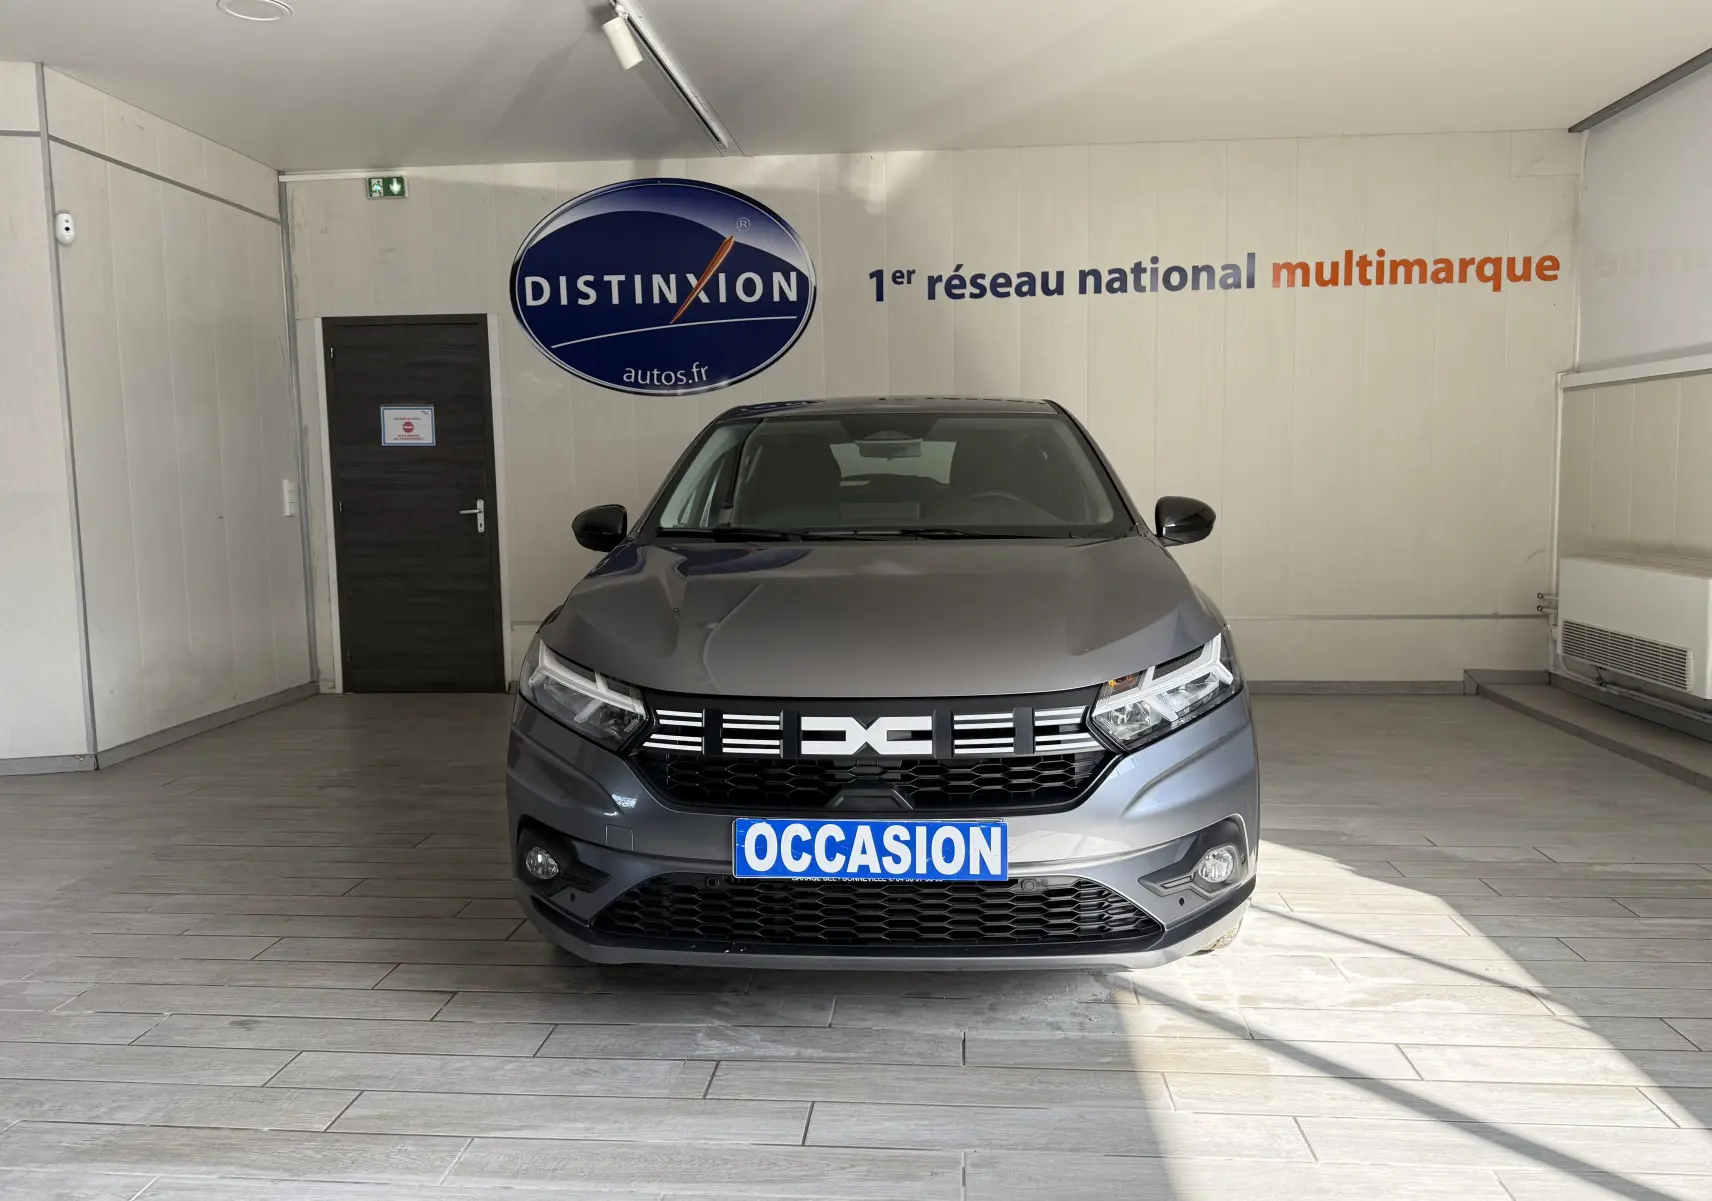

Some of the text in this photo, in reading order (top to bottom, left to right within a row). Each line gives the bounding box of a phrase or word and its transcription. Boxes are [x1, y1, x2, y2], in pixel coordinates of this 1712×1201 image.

[524, 271, 799, 307] DISTINXION
[926, 263, 1065, 301] réseau
[1078, 252, 1256, 295] national
[1271, 248, 1561, 292] multimarque
[622, 361, 709, 386] autos.fr
[744, 822, 1002, 875] OCCASION
